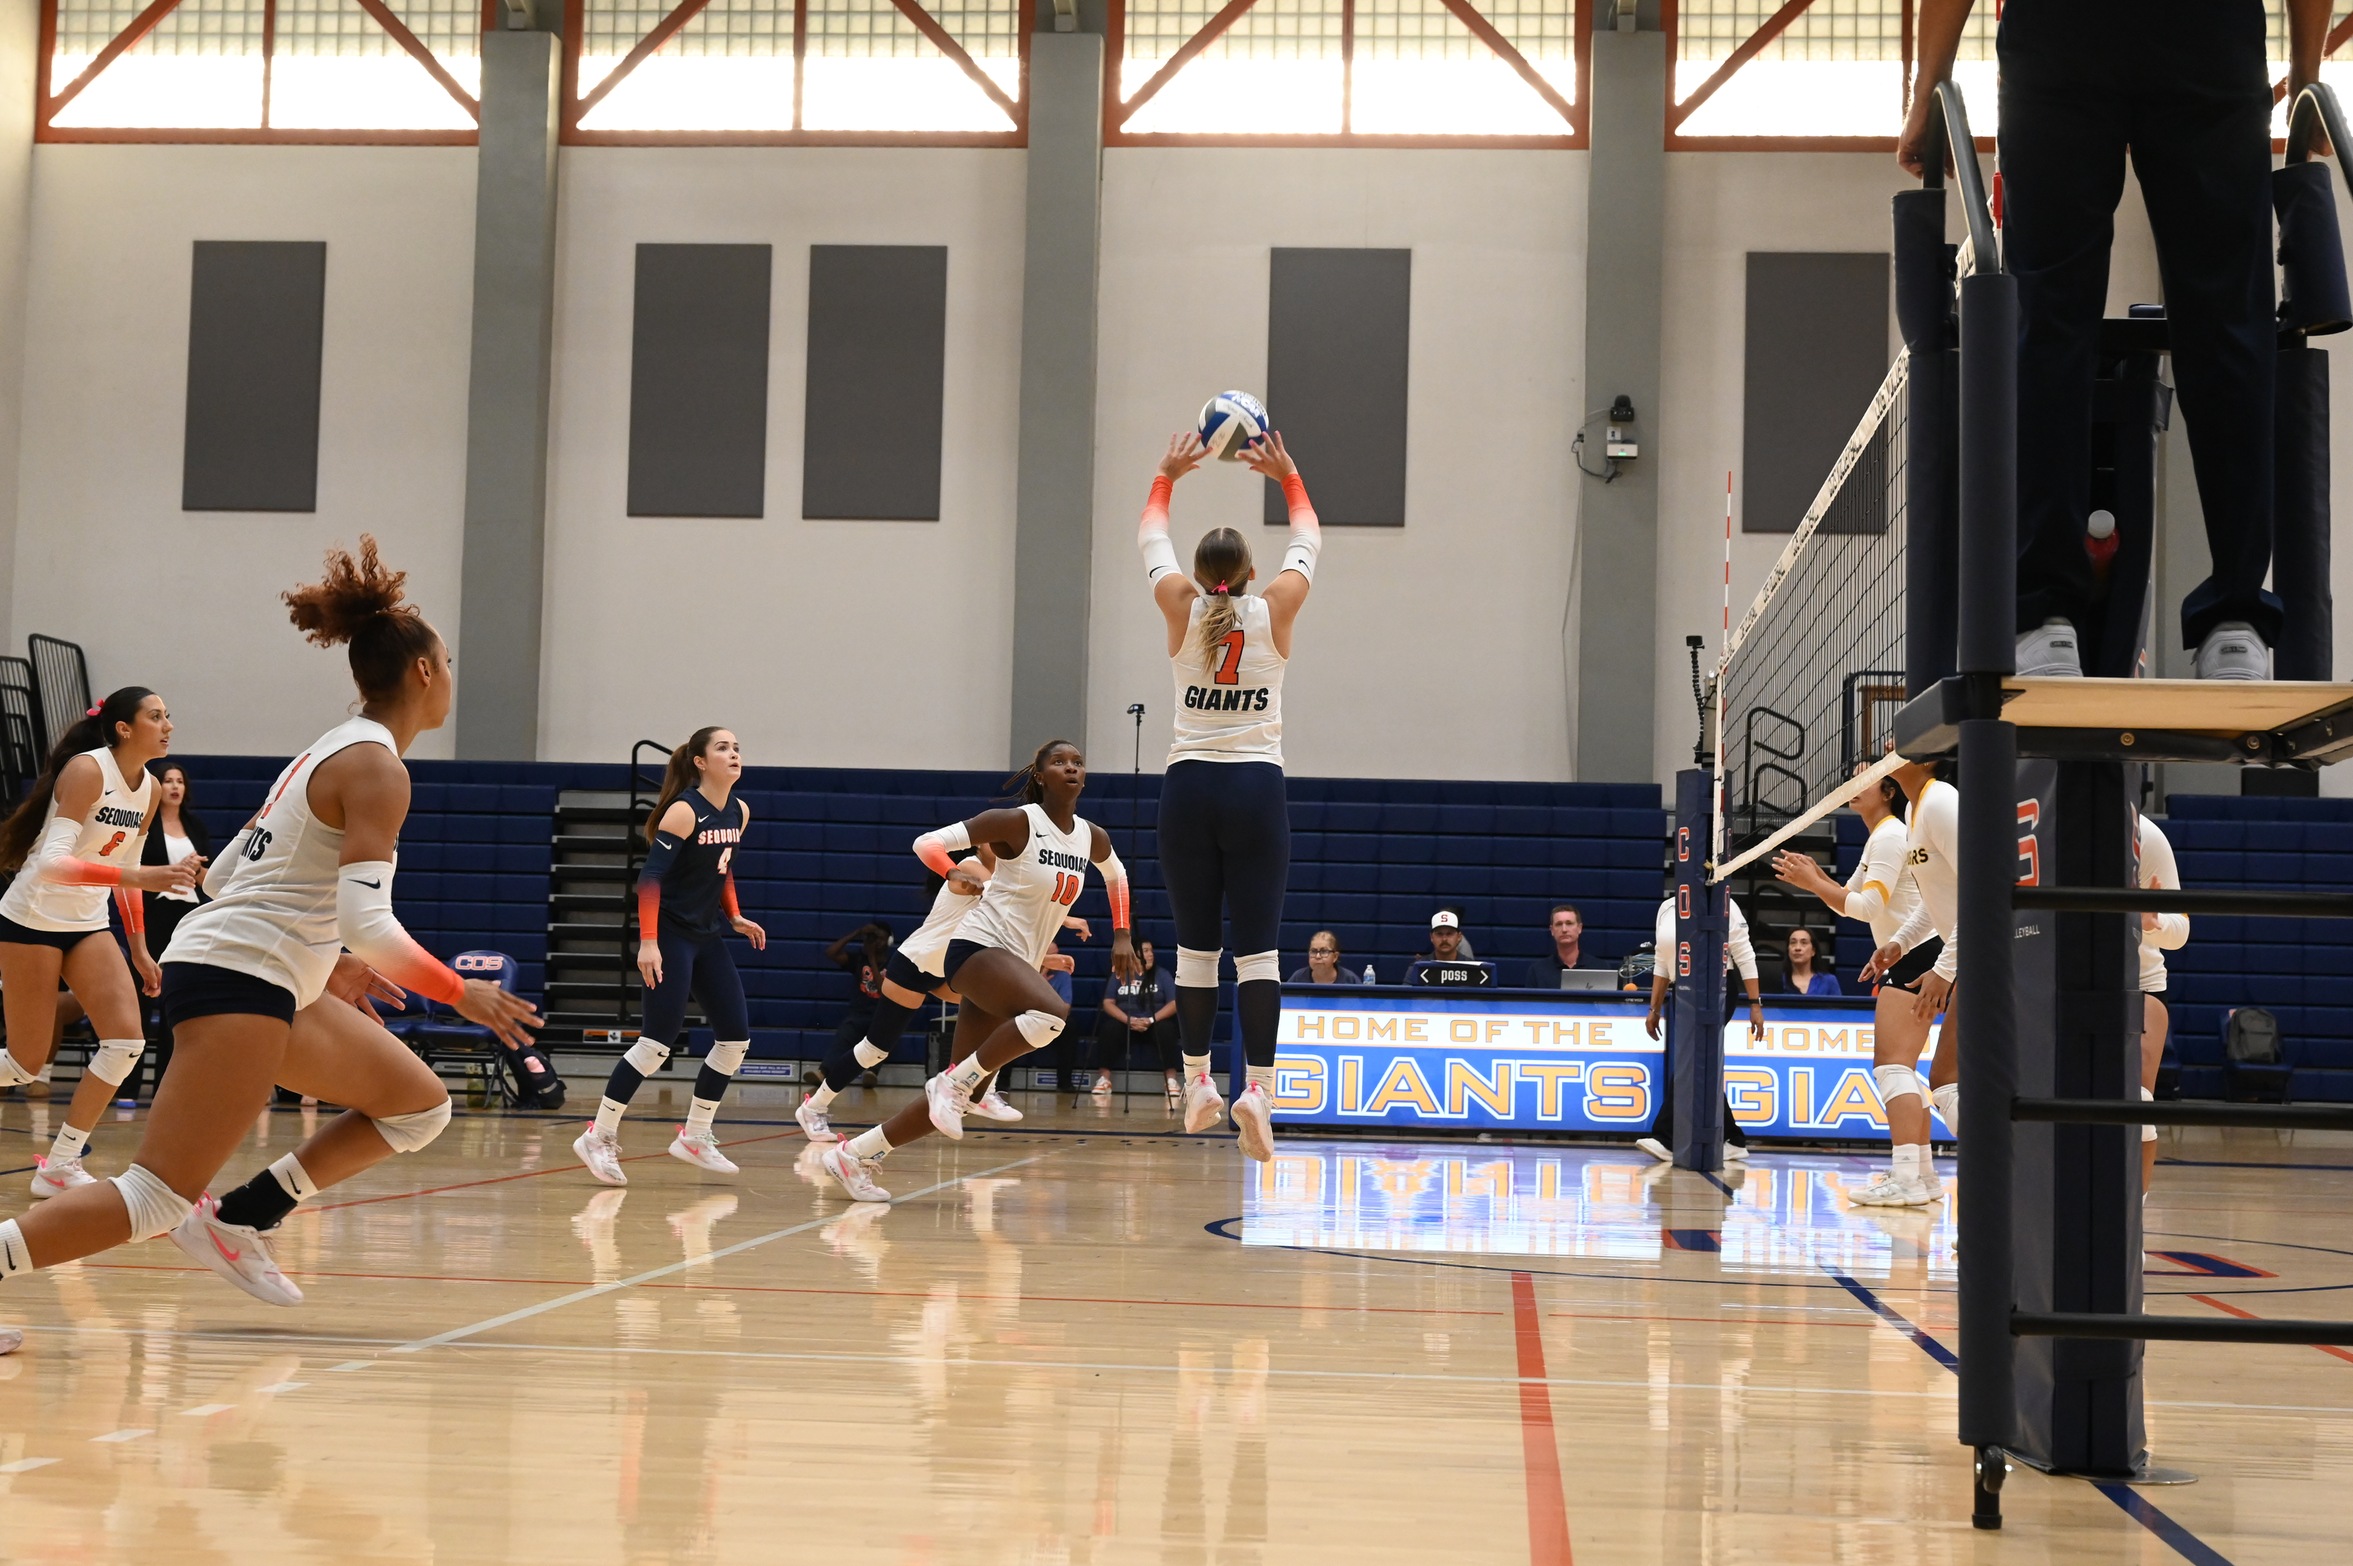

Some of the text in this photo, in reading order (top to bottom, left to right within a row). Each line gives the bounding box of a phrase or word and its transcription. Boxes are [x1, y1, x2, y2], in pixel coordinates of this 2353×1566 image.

[1212, 629, 1245, 685] 7
[1184, 685, 1269, 711] GIANTS
[717, 846, 733, 875] 4
[1050, 871, 1079, 906] 10
[1440, 914, 1449, 923] S
[2014, 924, 2041, 939] LEYBALL
[455, 956, 504, 971] COS
[1441, 969, 1468, 984] poss
[1297, 1015, 1613, 1046] HOME OF THE
[1746, 1027, 1875, 1053] HOME
[1272, 1053, 1651, 1123] GIANTS
